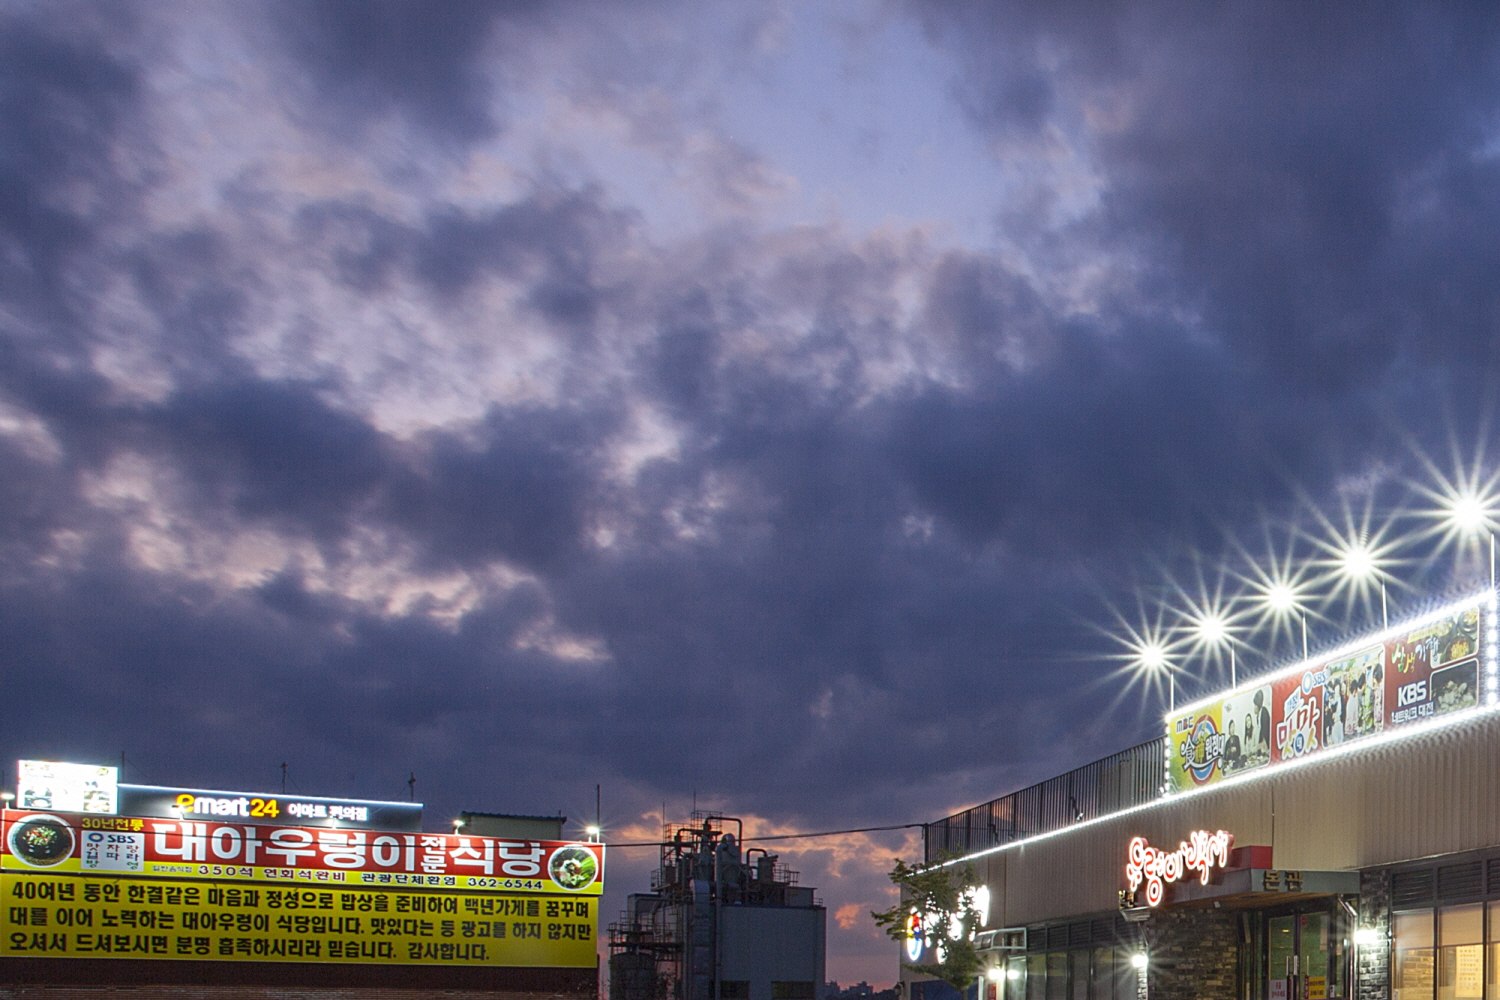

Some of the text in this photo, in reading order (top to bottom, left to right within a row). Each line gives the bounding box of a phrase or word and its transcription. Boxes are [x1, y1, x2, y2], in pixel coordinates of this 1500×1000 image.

[1313, 671, 1326, 687] SBS
[1397, 680, 1427, 708] KBS
[1418, 702, 1434, 717] 대전
[1176, 715, 1195, 733] MBC
[287, 802, 328, 819] 이마트
[81, 817, 145, 832] 30년전통
[107, 834, 136, 845] SBS
[151, 822, 416, 872] 대아우렁이
[448, 837, 546, 876] 식당
[198, 864, 253, 877] 350석
[263, 868, 346, 882] 연회석완비
[361, 872, 457, 886] 관광단체환영
[468, 876, 543, 890] 362-6544
[1264, 869, 1304, 892] 본관
[12, 881, 589, 918] 40여년 동안 한결같은 마음과 정성으로 밥상을 준비하여 백년가게를 꿈꾸며
[9, 906, 592, 941] 대를 이어 노력하는 대아우렁이 식당입니다. 맛있다는 등 광고를 하지 않지만
[10, 932, 67, 952] 오셔서
[76, 933, 168, 954] 드셔보시면
[176, 936, 211, 956] 분명
[328, 939, 397, 959] 믿습니다.
[408, 942, 490, 960] 감사합니다.
